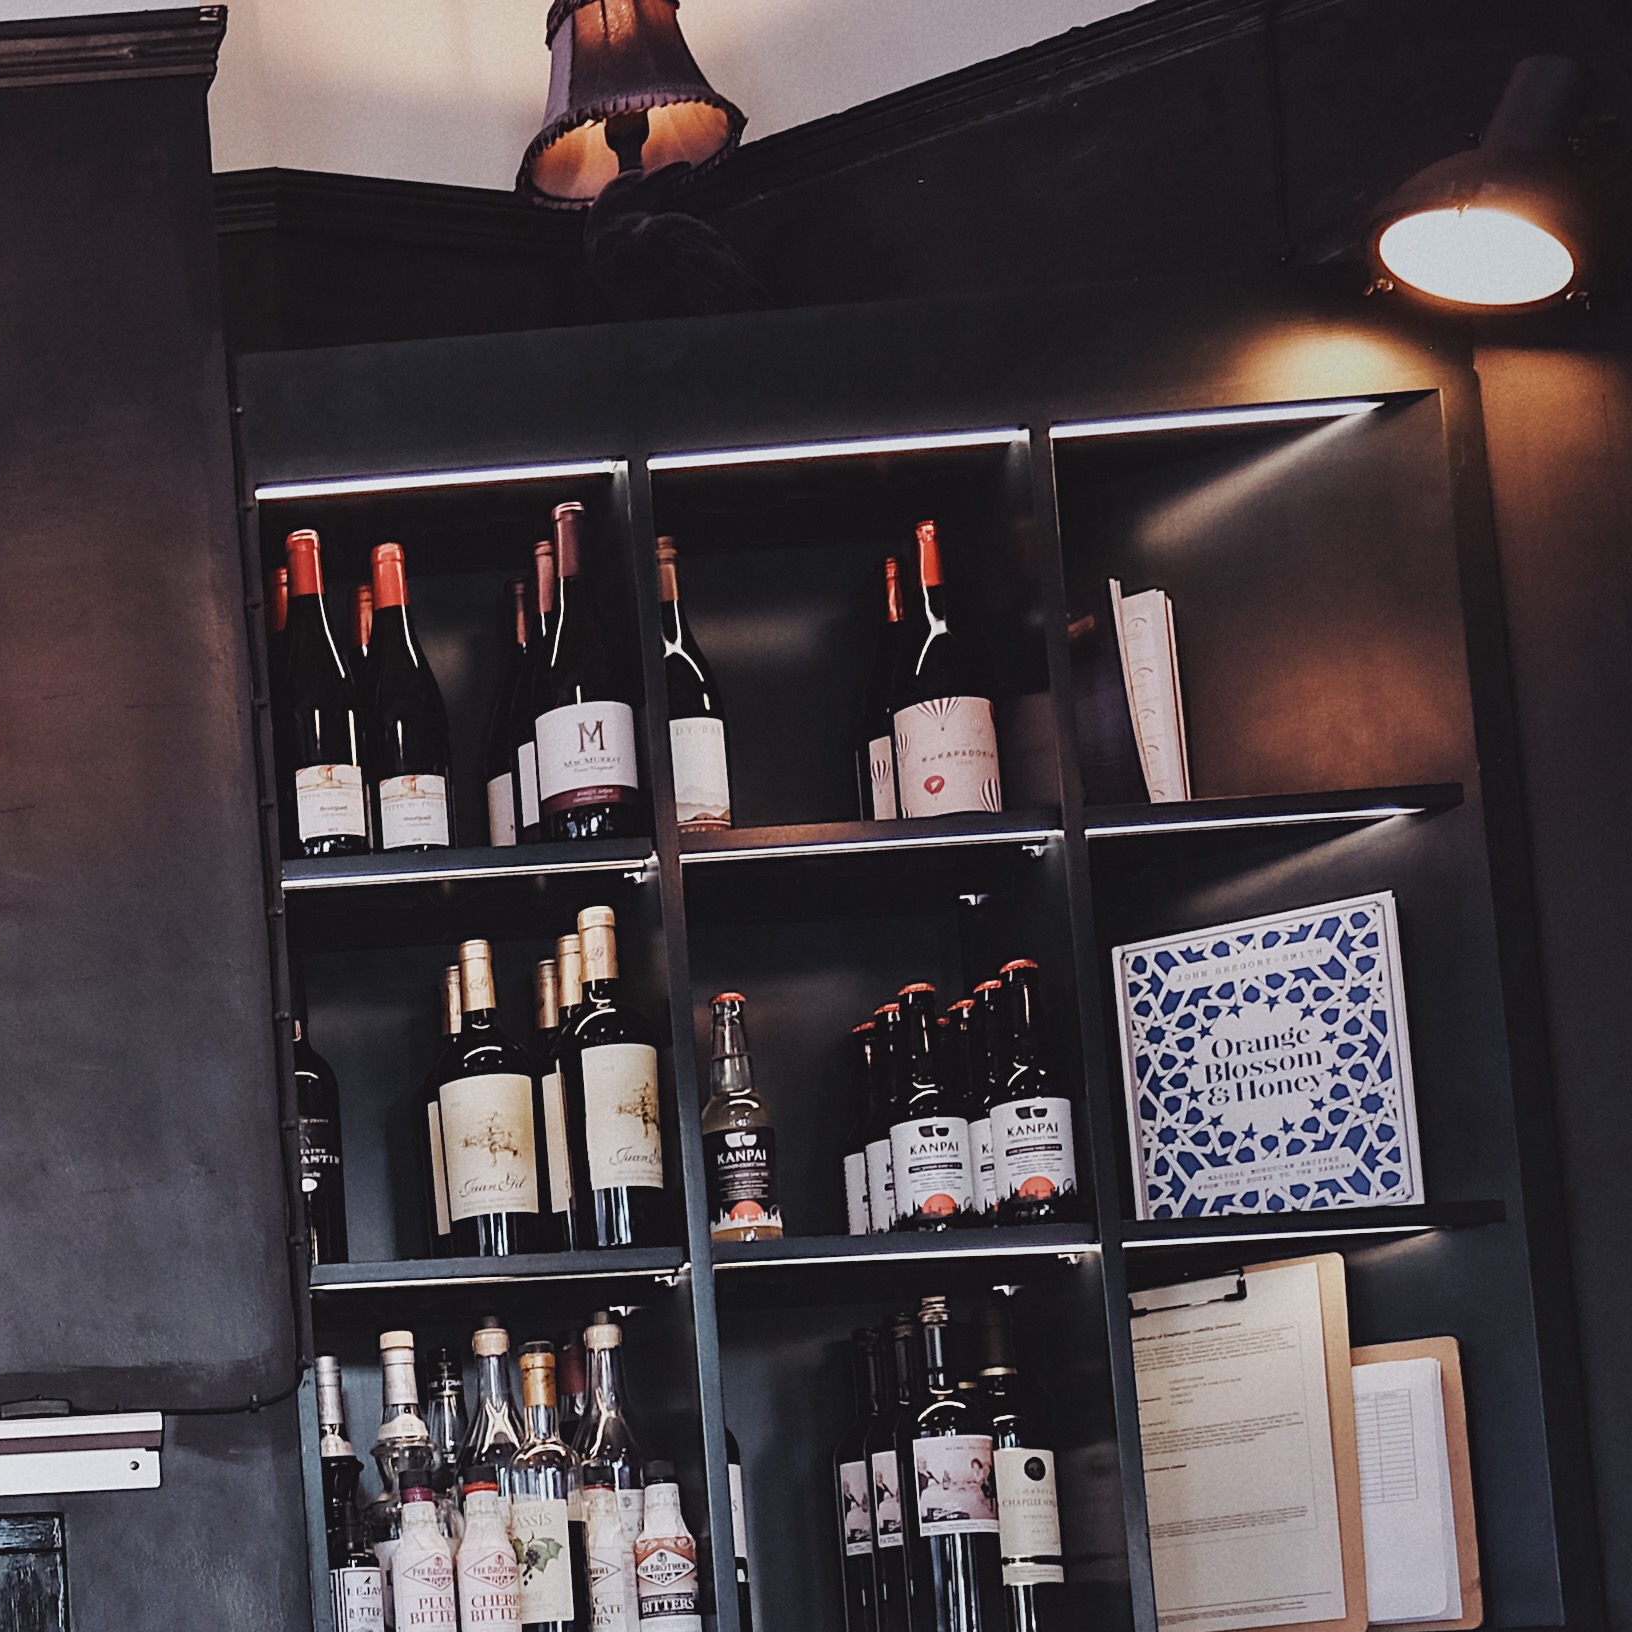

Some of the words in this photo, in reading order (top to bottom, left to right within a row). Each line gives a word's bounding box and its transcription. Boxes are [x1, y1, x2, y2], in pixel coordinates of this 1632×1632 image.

[577, 719, 605, 753] M
[1176, 971, 1207, 983] JOHN
[1210, 1026, 1311, 1060] Orange
[1204, 1049, 1322, 1085] Blossom
[1208, 1086, 1231, 1107] &
[1236, 1071, 1326, 1102] Honey
[1007, 1121, 1059, 1137] KANPAI
[610, 1145, 649, 1166] Juan
[717, 1148, 767, 1165] KANPAI
[909, 1141, 960, 1155] KANPAI
[459, 1177, 496, 1198] Juan
[496, 1171, 527, 1192] Gil
[516, 1512, 552, 1529] ASSIS
[642, 1597, 695, 1615] BITTERS
